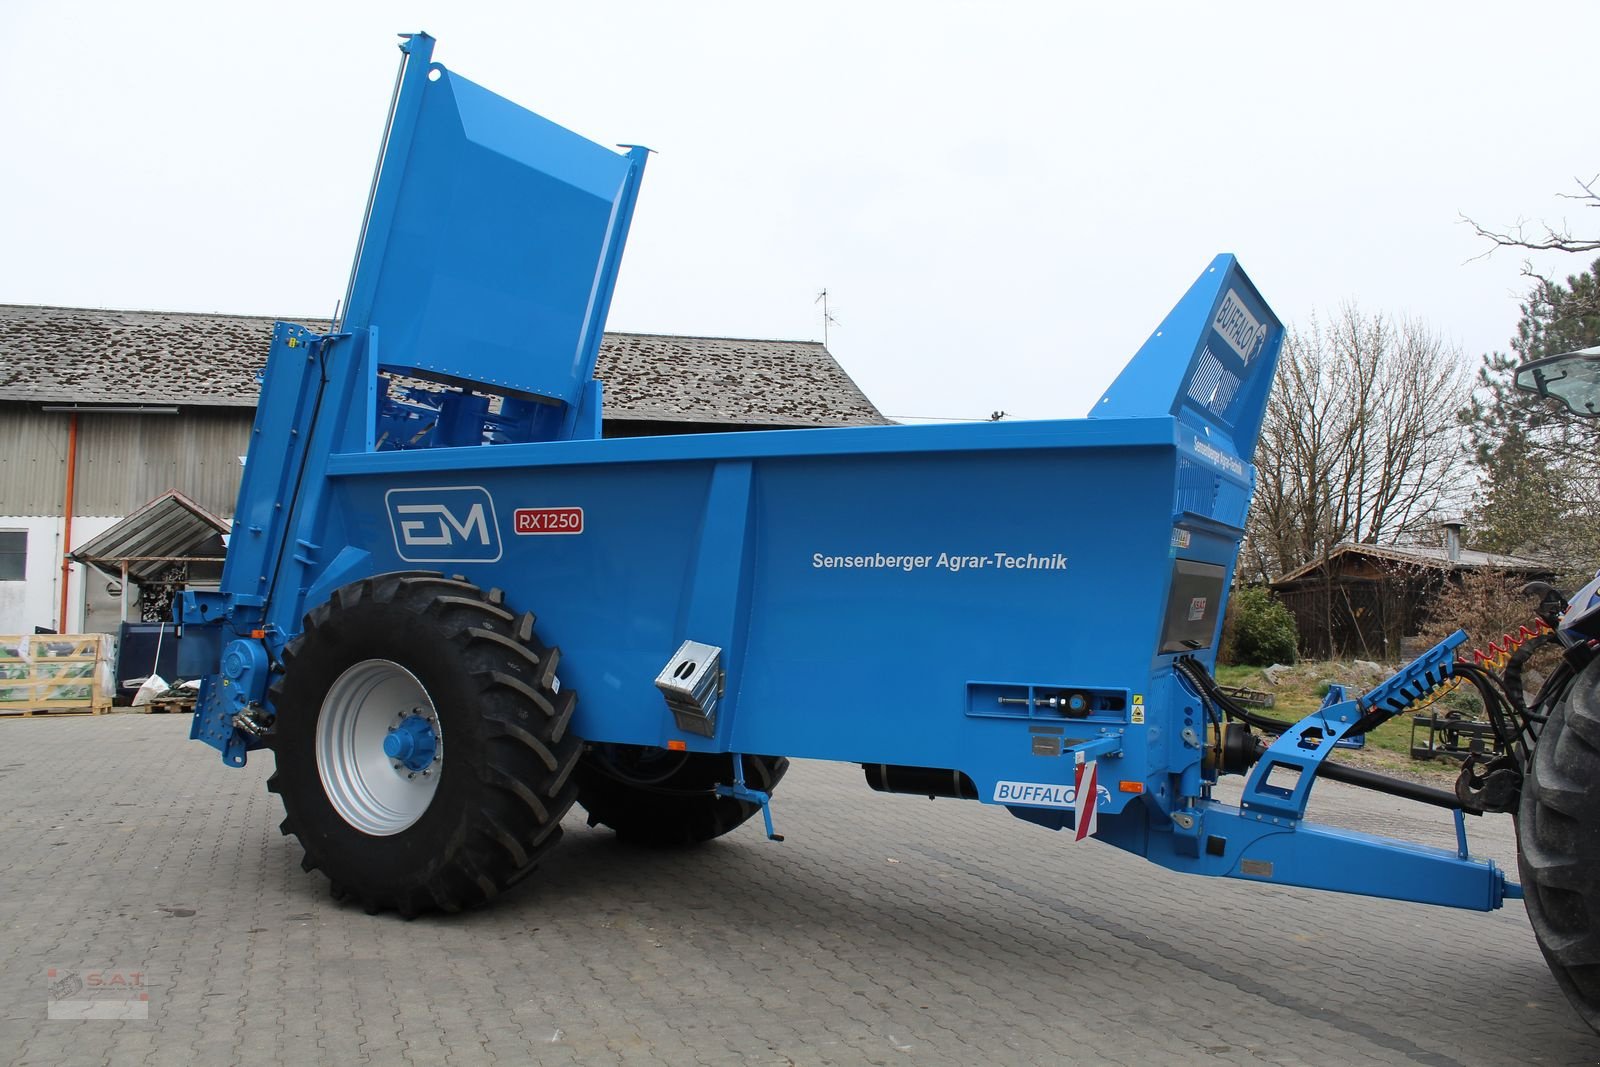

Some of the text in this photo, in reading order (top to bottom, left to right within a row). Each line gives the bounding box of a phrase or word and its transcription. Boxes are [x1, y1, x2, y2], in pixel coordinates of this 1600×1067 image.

[1216, 296, 1254, 350] BUFFALO
[397, 503, 490, 545] EM
[519, 513, 579, 529] RX1250
[812, 552, 1068, 572] Sensenberger Agrar-Technik
[999, 784, 1076, 803] BUFFALO
